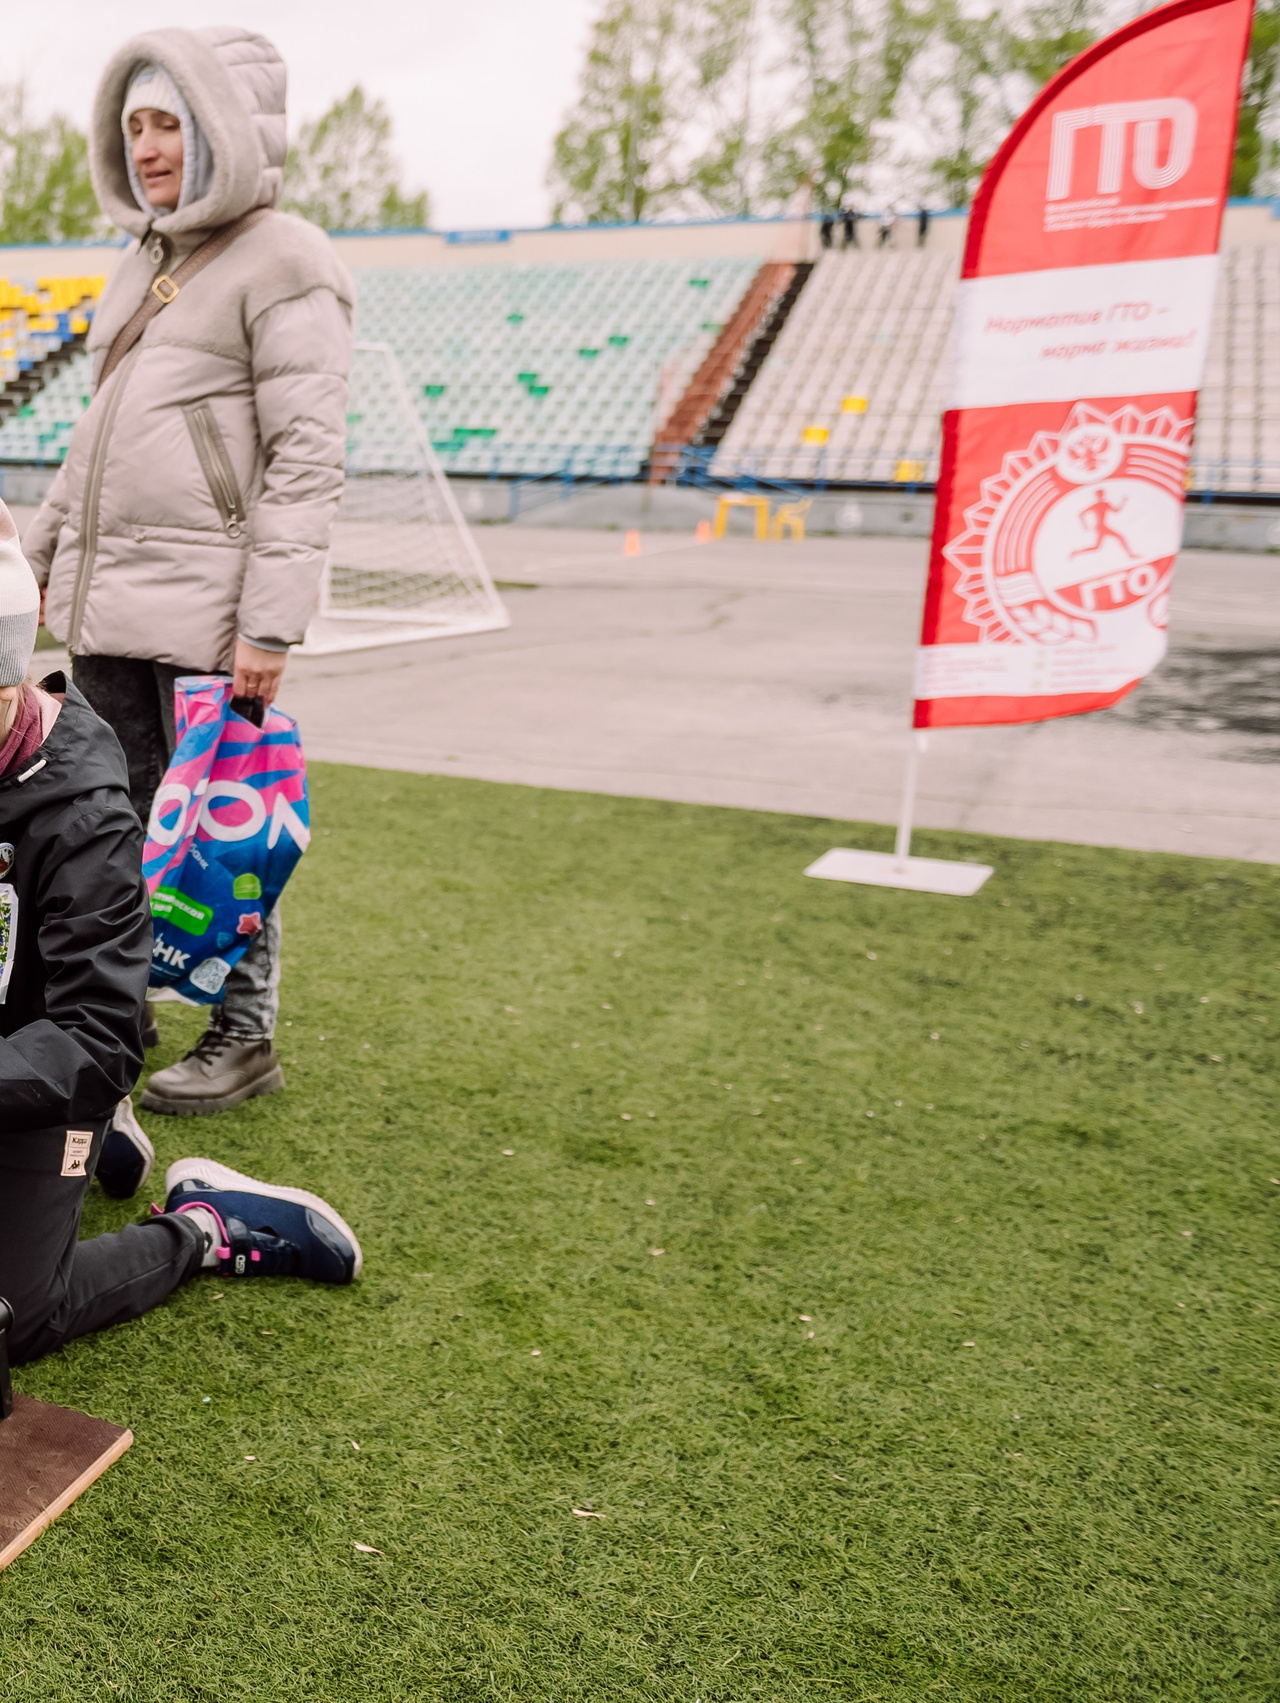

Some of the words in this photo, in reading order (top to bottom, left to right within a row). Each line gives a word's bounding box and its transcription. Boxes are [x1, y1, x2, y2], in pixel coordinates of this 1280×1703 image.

[1046, 98, 1198, 201] ГТО
[1107, 302, 1151, 322] ГТО
[1079, 565, 1158, 611] ГТО
